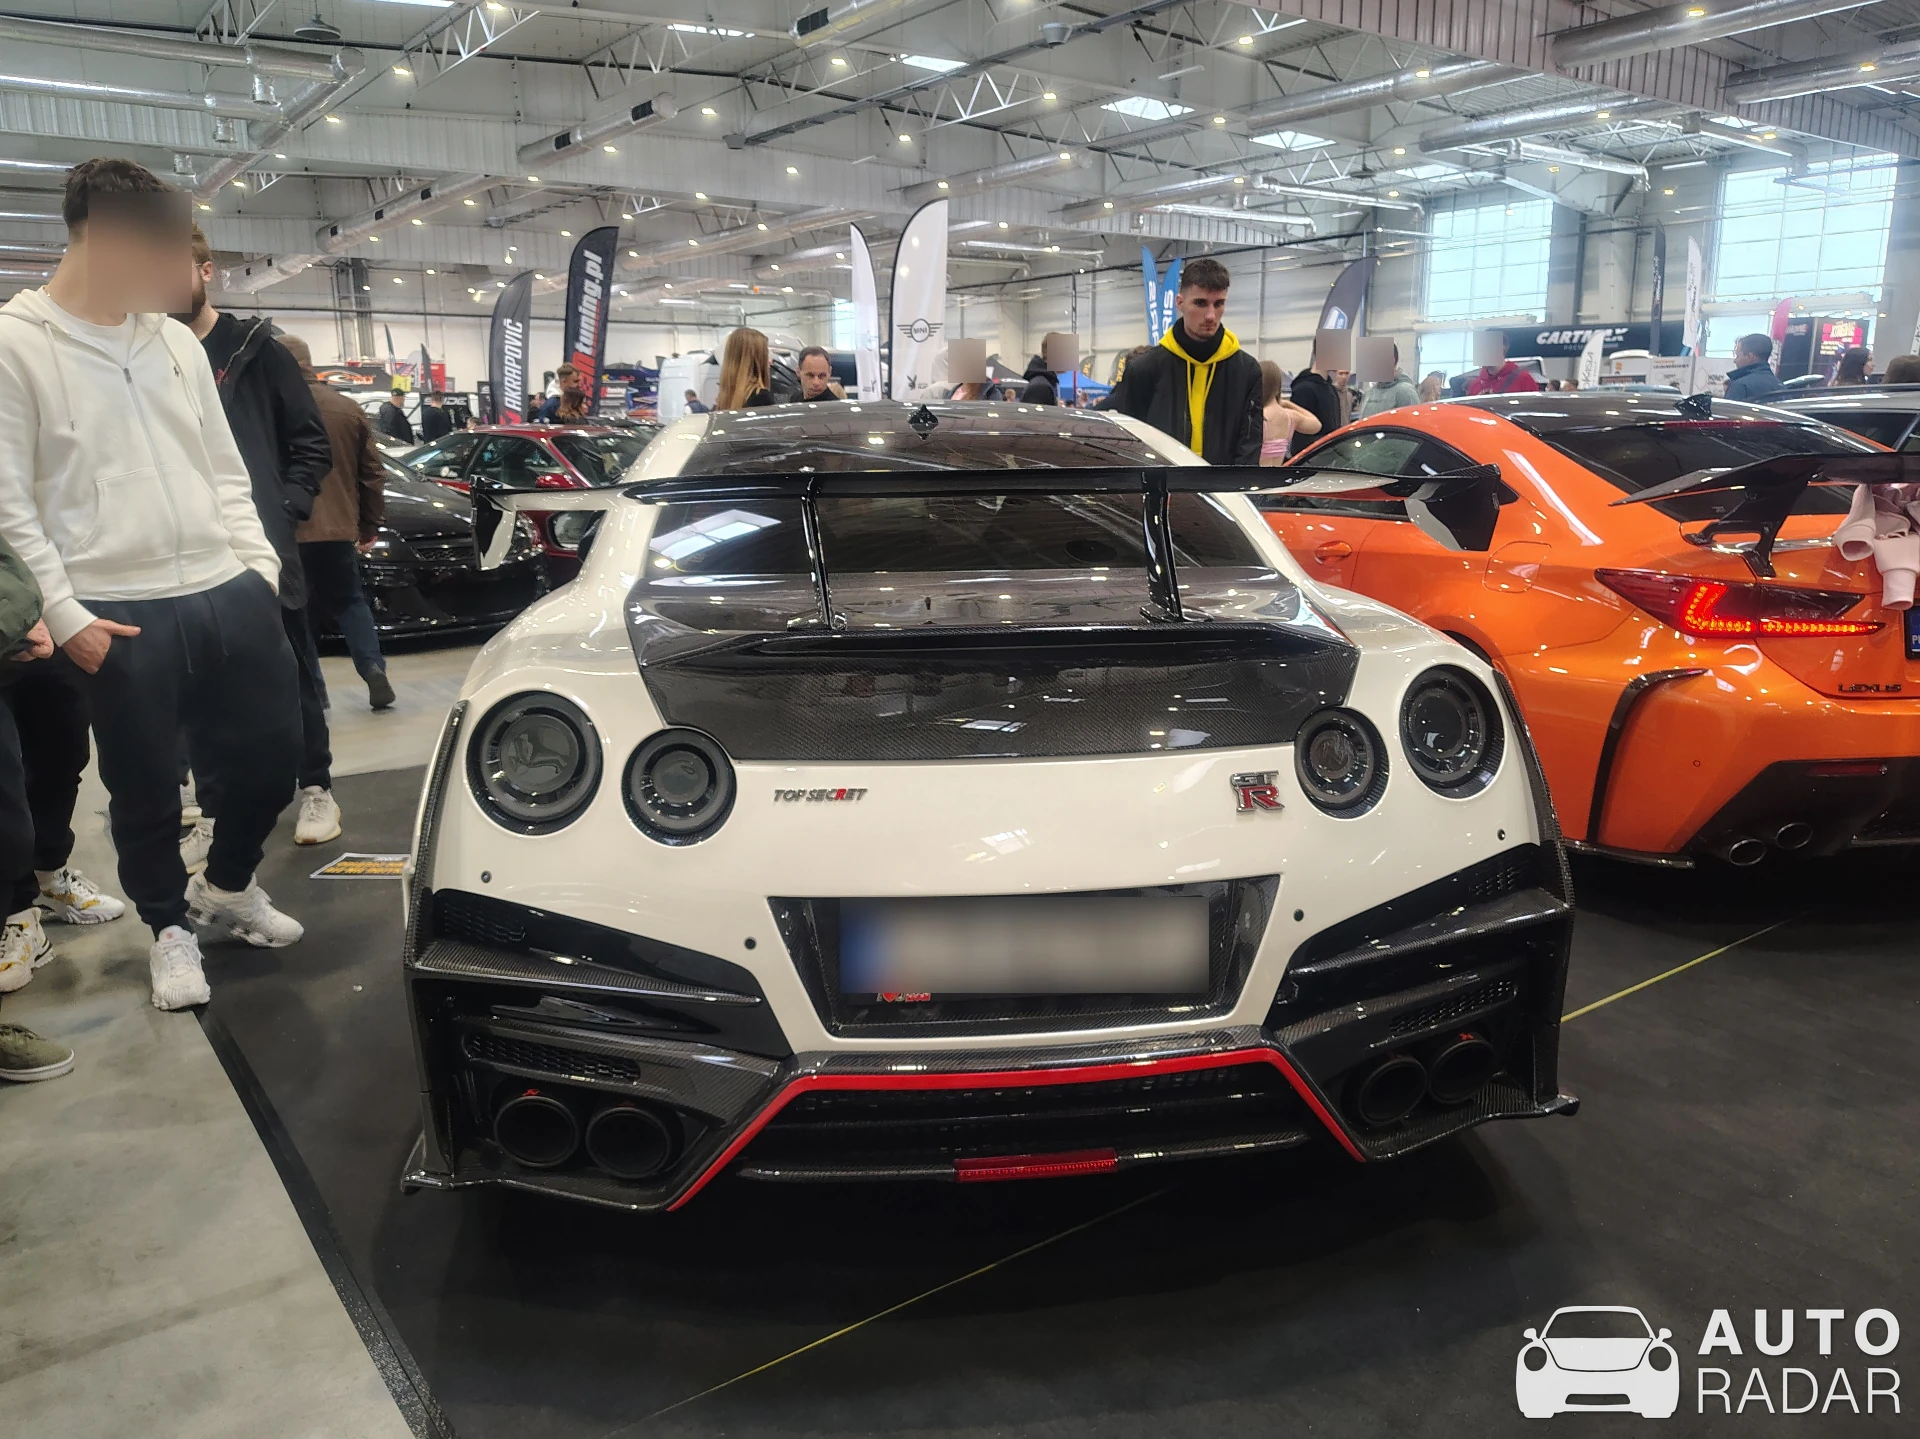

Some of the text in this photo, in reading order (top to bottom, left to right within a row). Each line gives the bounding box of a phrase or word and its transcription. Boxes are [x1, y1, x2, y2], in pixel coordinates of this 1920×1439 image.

[503, 317, 523, 412] AKRAPOVIČ
[423, 396, 468, 407] SIDE
[1838, 684, 1901, 692] LEXUS
[774, 788, 868, 801] TOP SECRET
